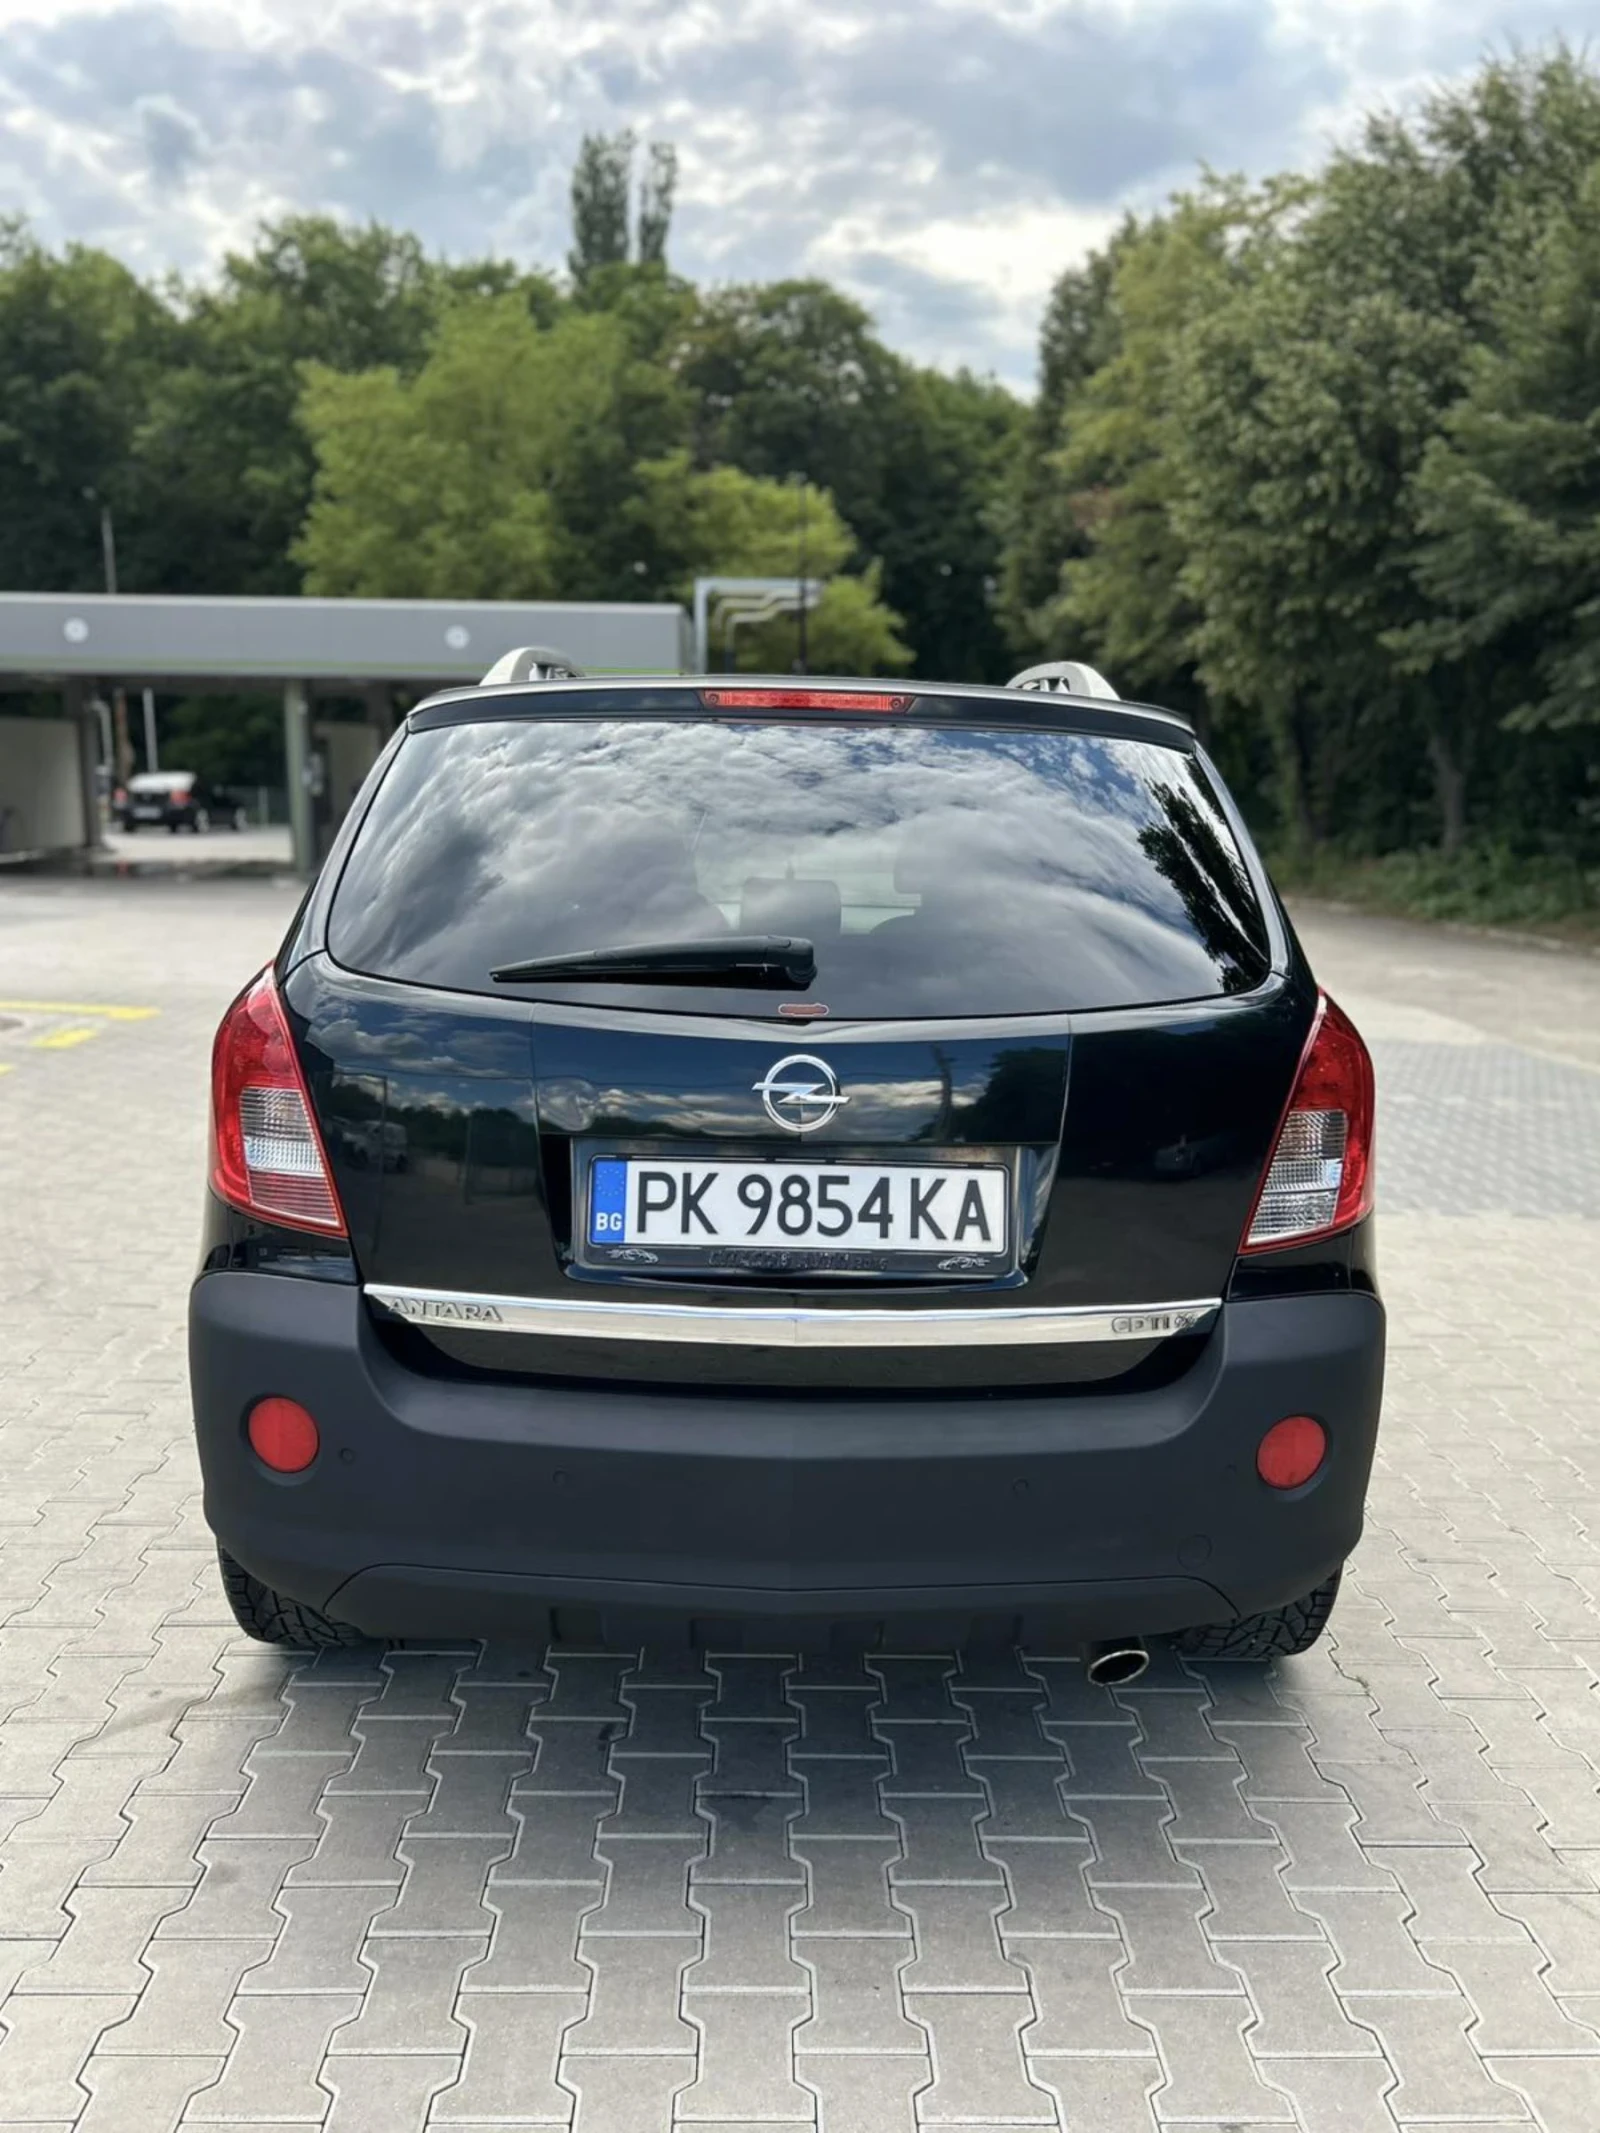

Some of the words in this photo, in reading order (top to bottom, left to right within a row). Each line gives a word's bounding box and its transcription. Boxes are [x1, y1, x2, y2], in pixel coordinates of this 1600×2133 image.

[637, 1171, 720, 1236] PK
[737, 1174, 894, 1239] 9854
[909, 1177, 992, 1242] KA
[596, 1212, 623, 1231] BG
[389, 1298, 504, 1323] ANTARA
